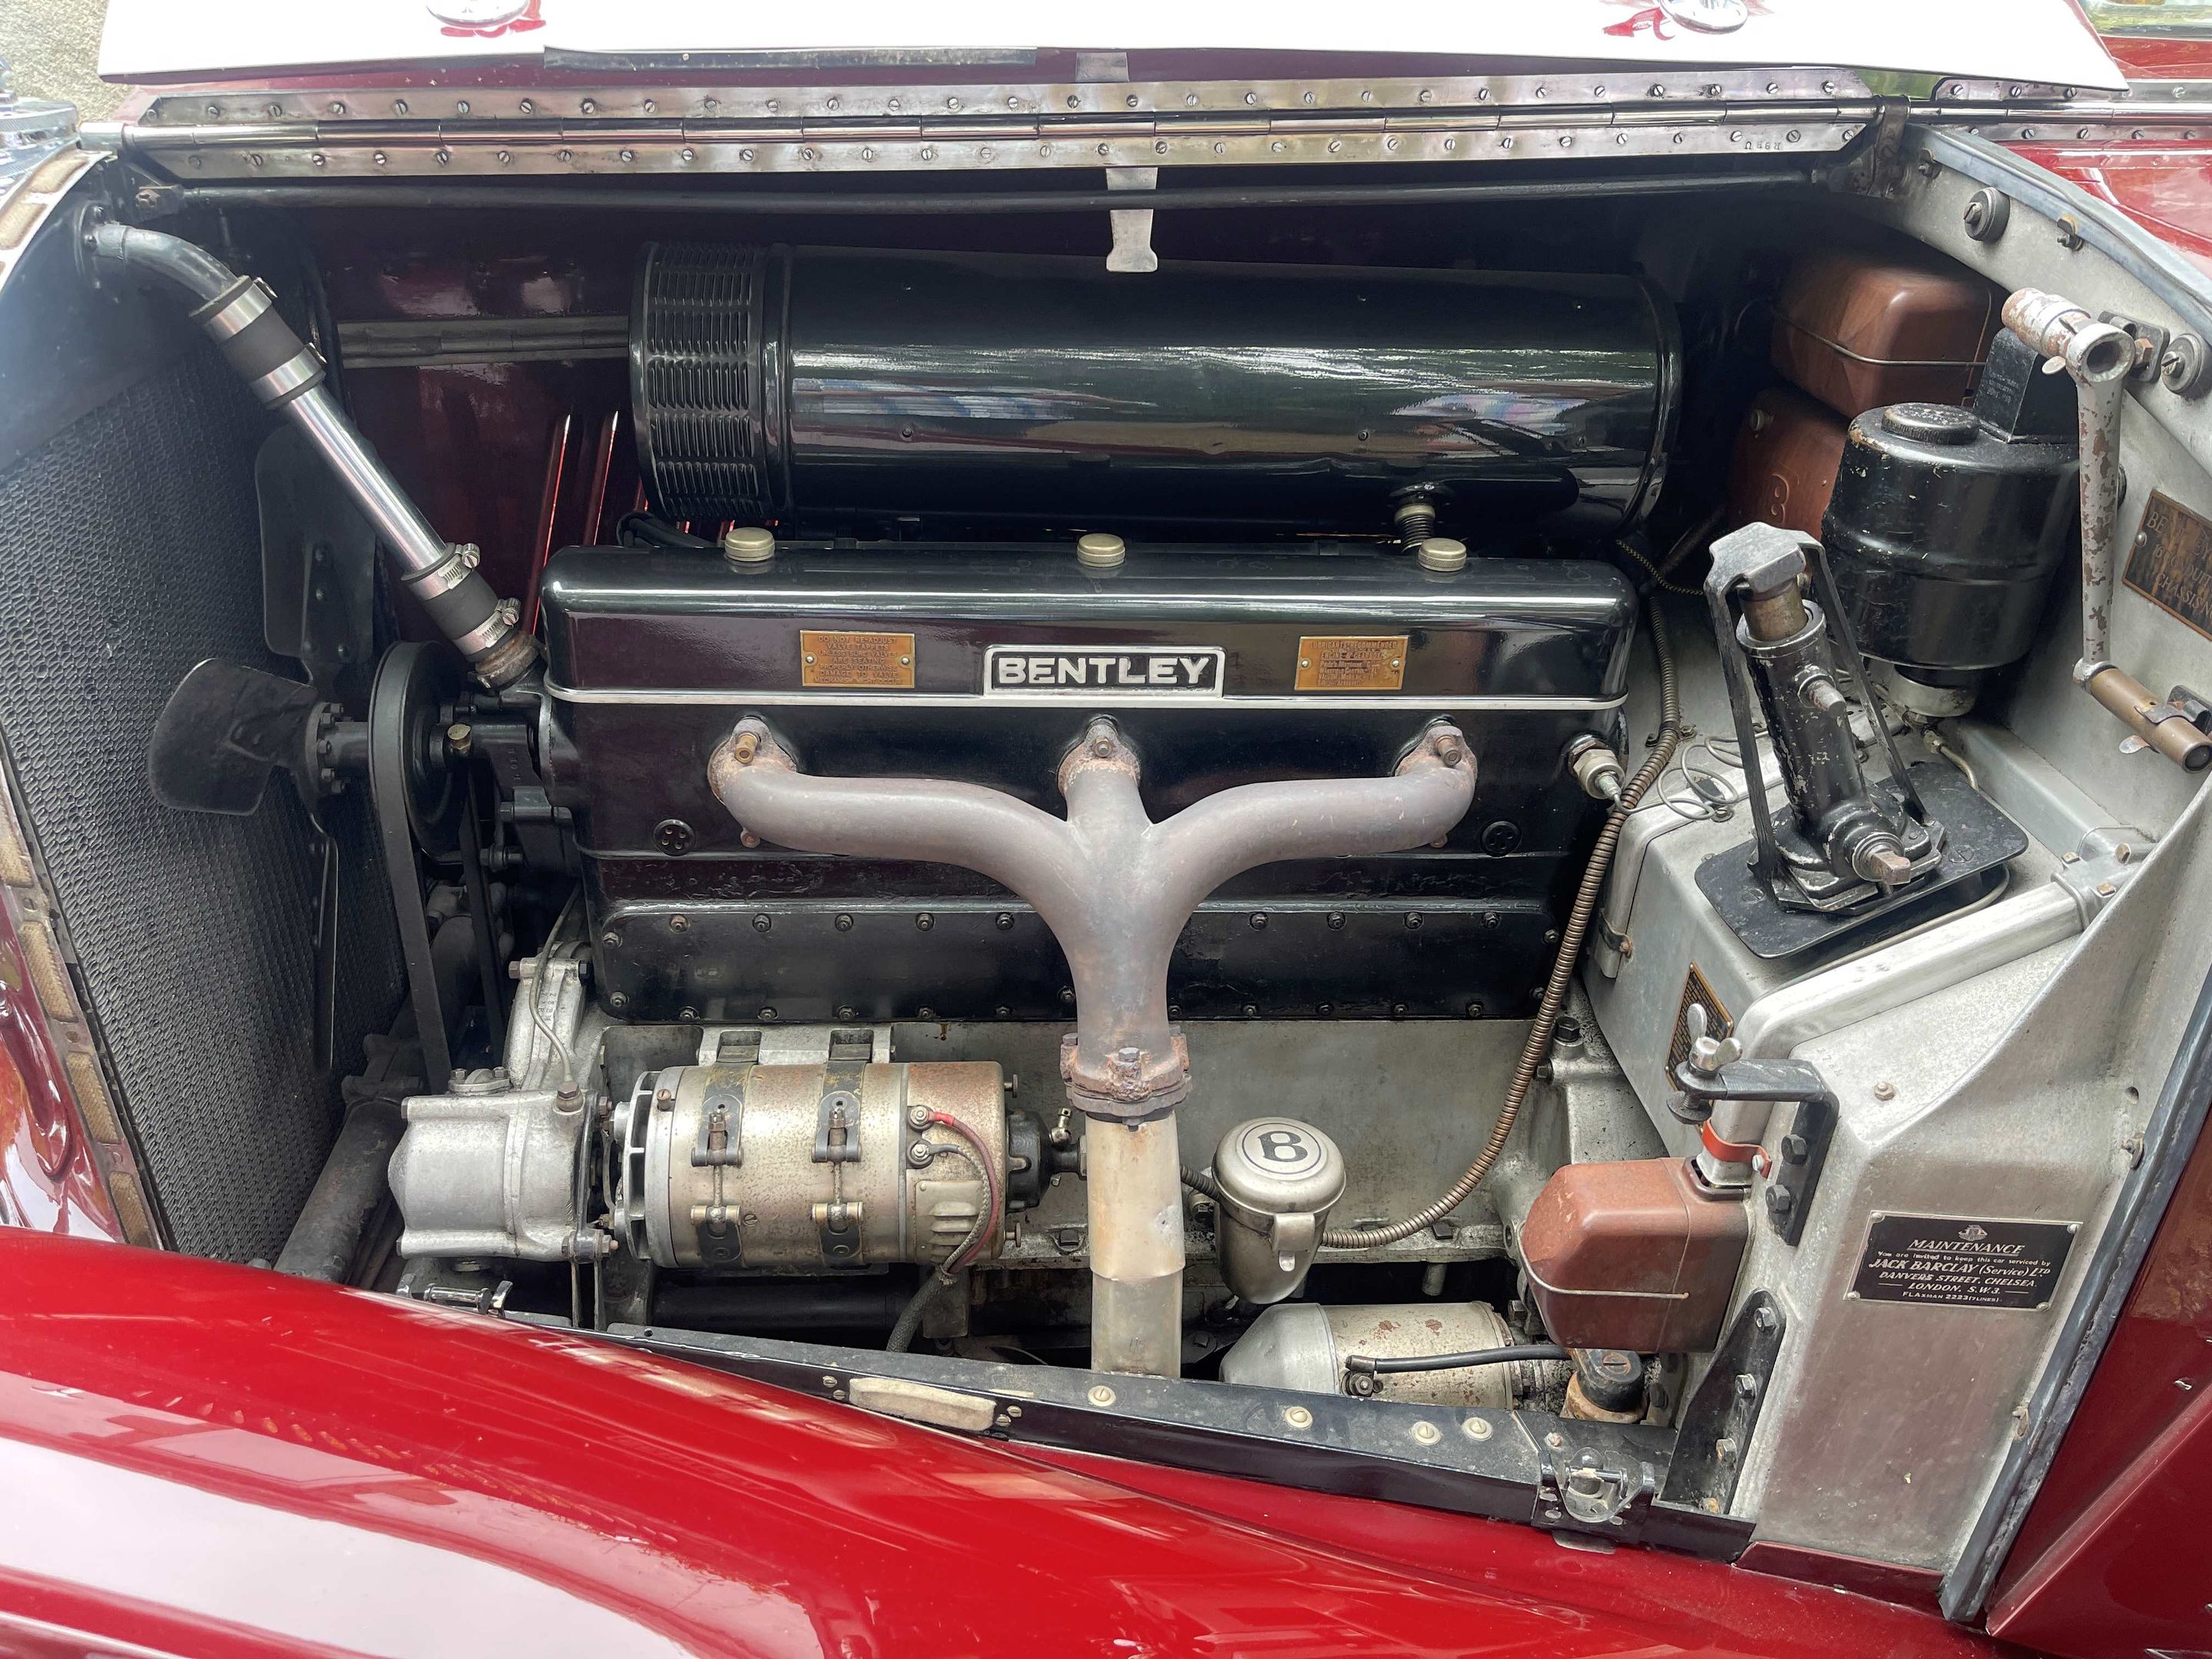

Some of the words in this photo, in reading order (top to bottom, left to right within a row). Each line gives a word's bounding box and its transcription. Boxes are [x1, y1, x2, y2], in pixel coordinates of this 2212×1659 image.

[2158, 573, 2203, 609] CHASSIS
[998, 656, 1210, 684] BENTLEY
[1257, 1131, 1308, 1162] B
[1909, 1239, 2026, 1253] MAINTENANCE
[1869, 1258, 1911, 1270] JACK
[1909, 1260, 1980, 1273] BARCLAY
[1979, 1263, 2030, 1277] (Service)
[1955, 1255, 1973, 1263] keep
[1879, 1271, 1935, 1281] DANVERS
